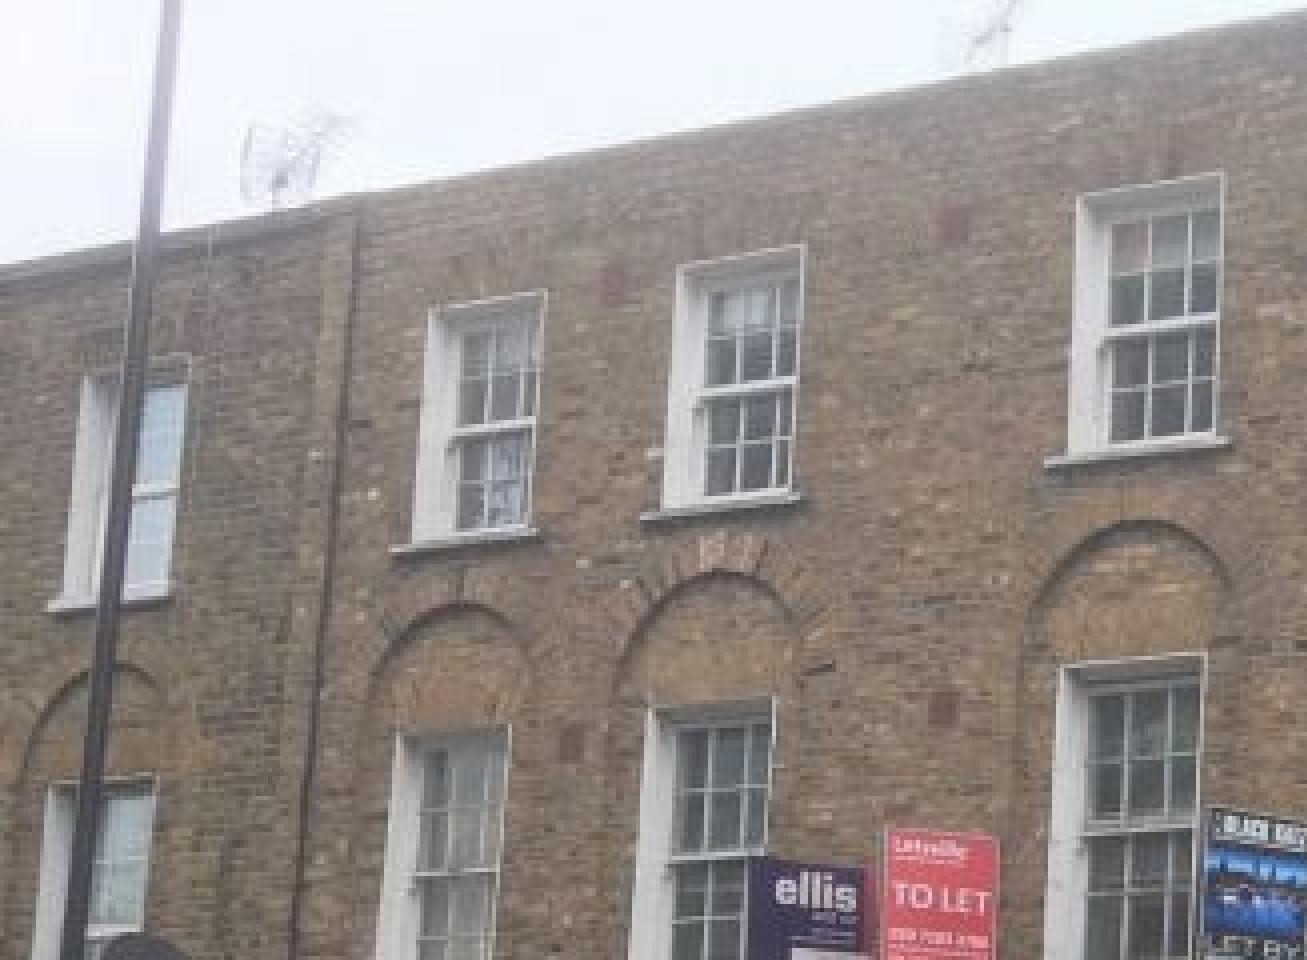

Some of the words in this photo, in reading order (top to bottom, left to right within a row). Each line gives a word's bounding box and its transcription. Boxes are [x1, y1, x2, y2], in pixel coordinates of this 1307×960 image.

[775, 871, 857, 912] ellis
[893, 883, 933, 908] TO
[942, 887, 992, 916] LET
